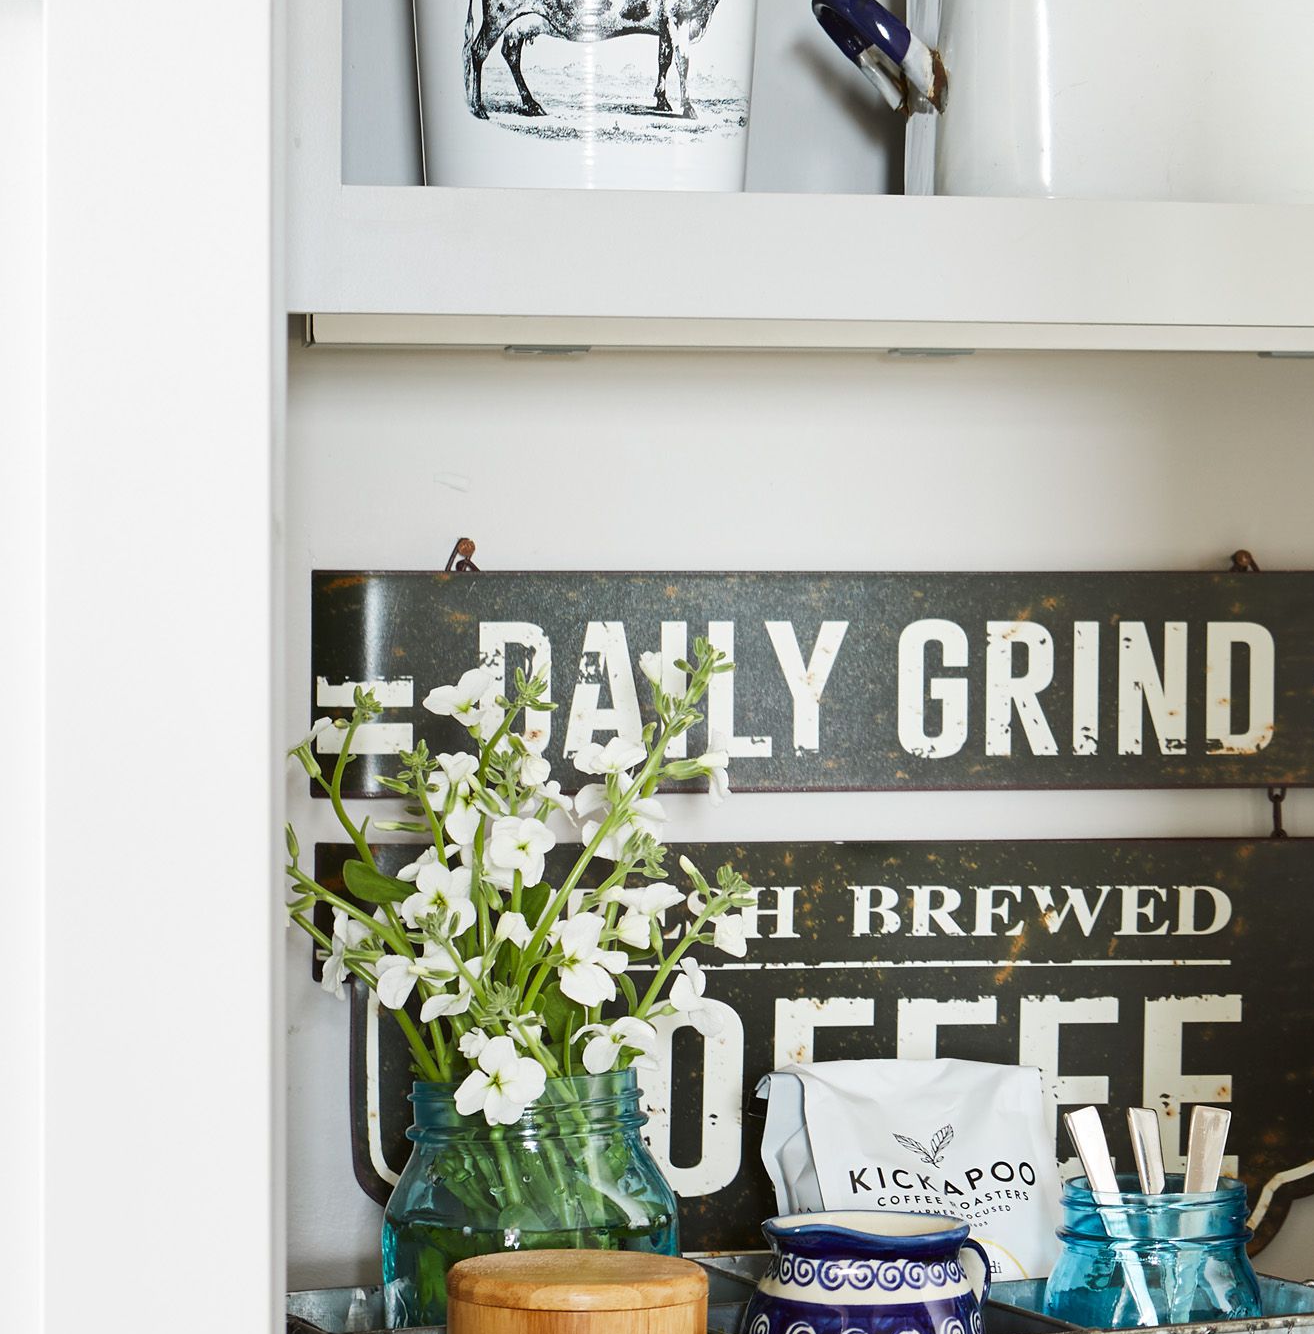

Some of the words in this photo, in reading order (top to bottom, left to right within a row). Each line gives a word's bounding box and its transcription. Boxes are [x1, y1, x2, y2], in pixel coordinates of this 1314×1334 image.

[479, 620, 850, 759] DAILY
[898, 618, 1275, 759] GRIND
[847, 884, 1233, 938] BREWED
[638, 993, 1243, 1198] OEE
[849, 1160, 1036, 1196] KICKAPOO
[877, 1195, 943, 1207] COFFEE
